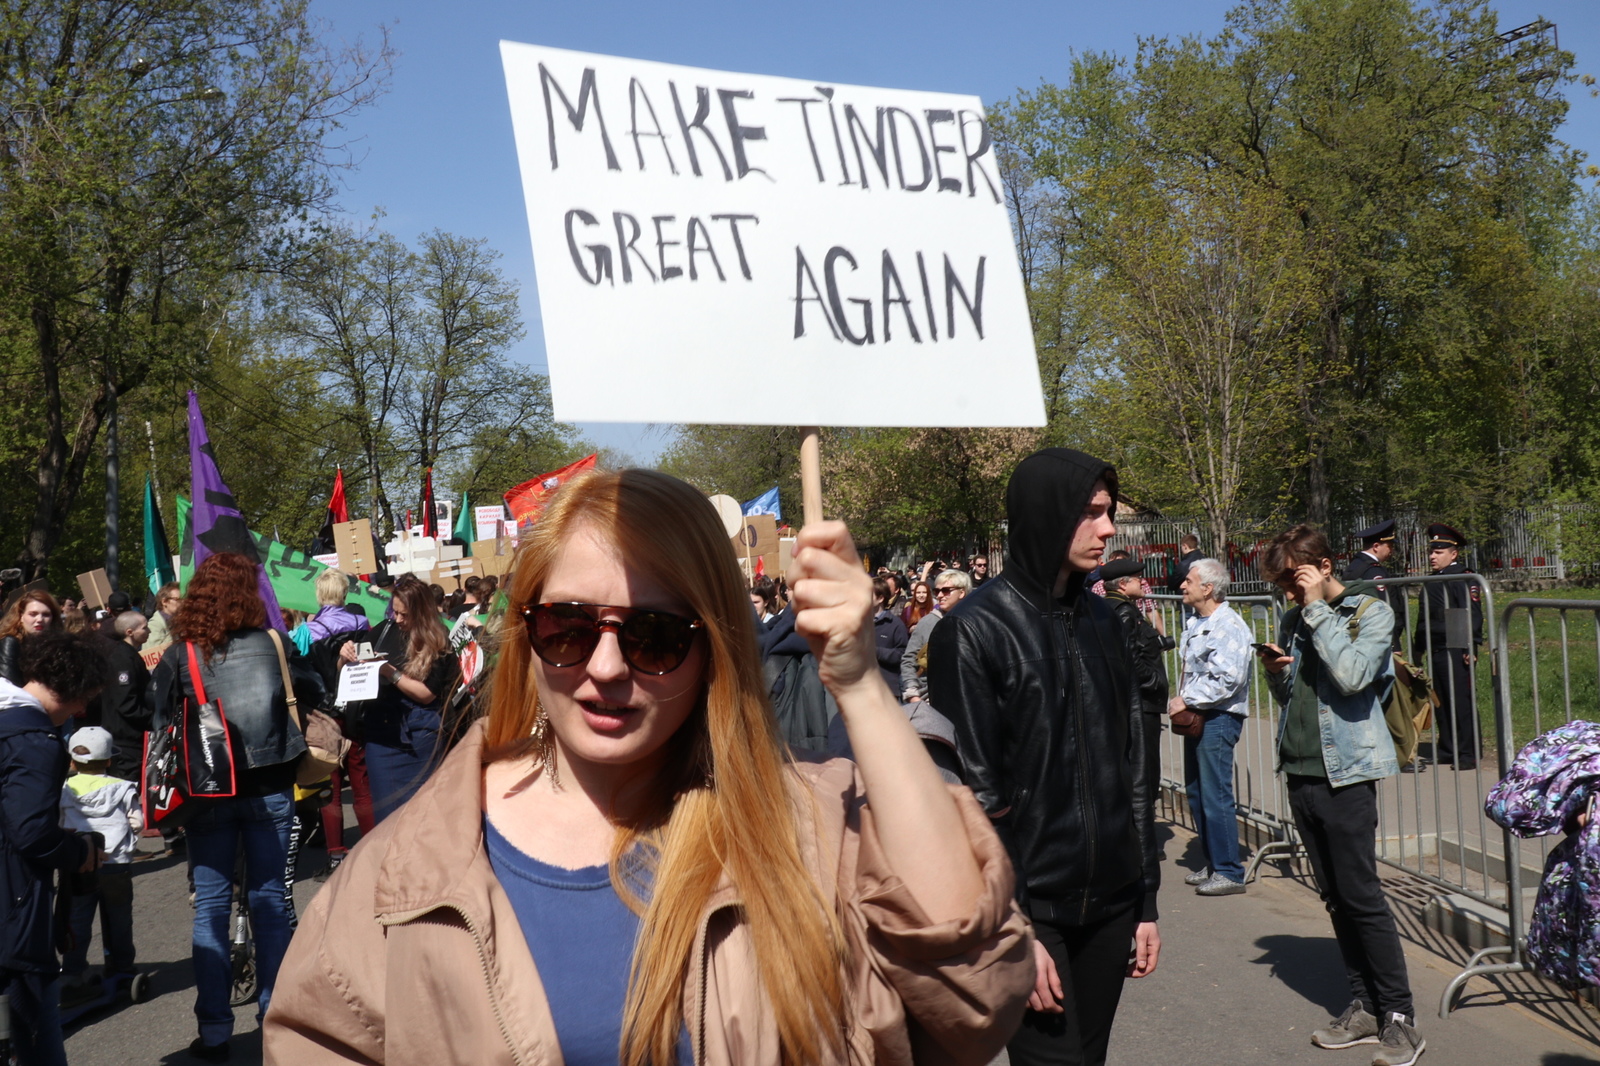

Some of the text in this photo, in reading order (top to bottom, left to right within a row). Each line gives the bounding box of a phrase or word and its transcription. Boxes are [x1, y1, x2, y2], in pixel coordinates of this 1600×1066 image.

[537, 61, 1001, 205] MAKE TINDER
[564, 208, 986, 346] GREAT AGAIN
